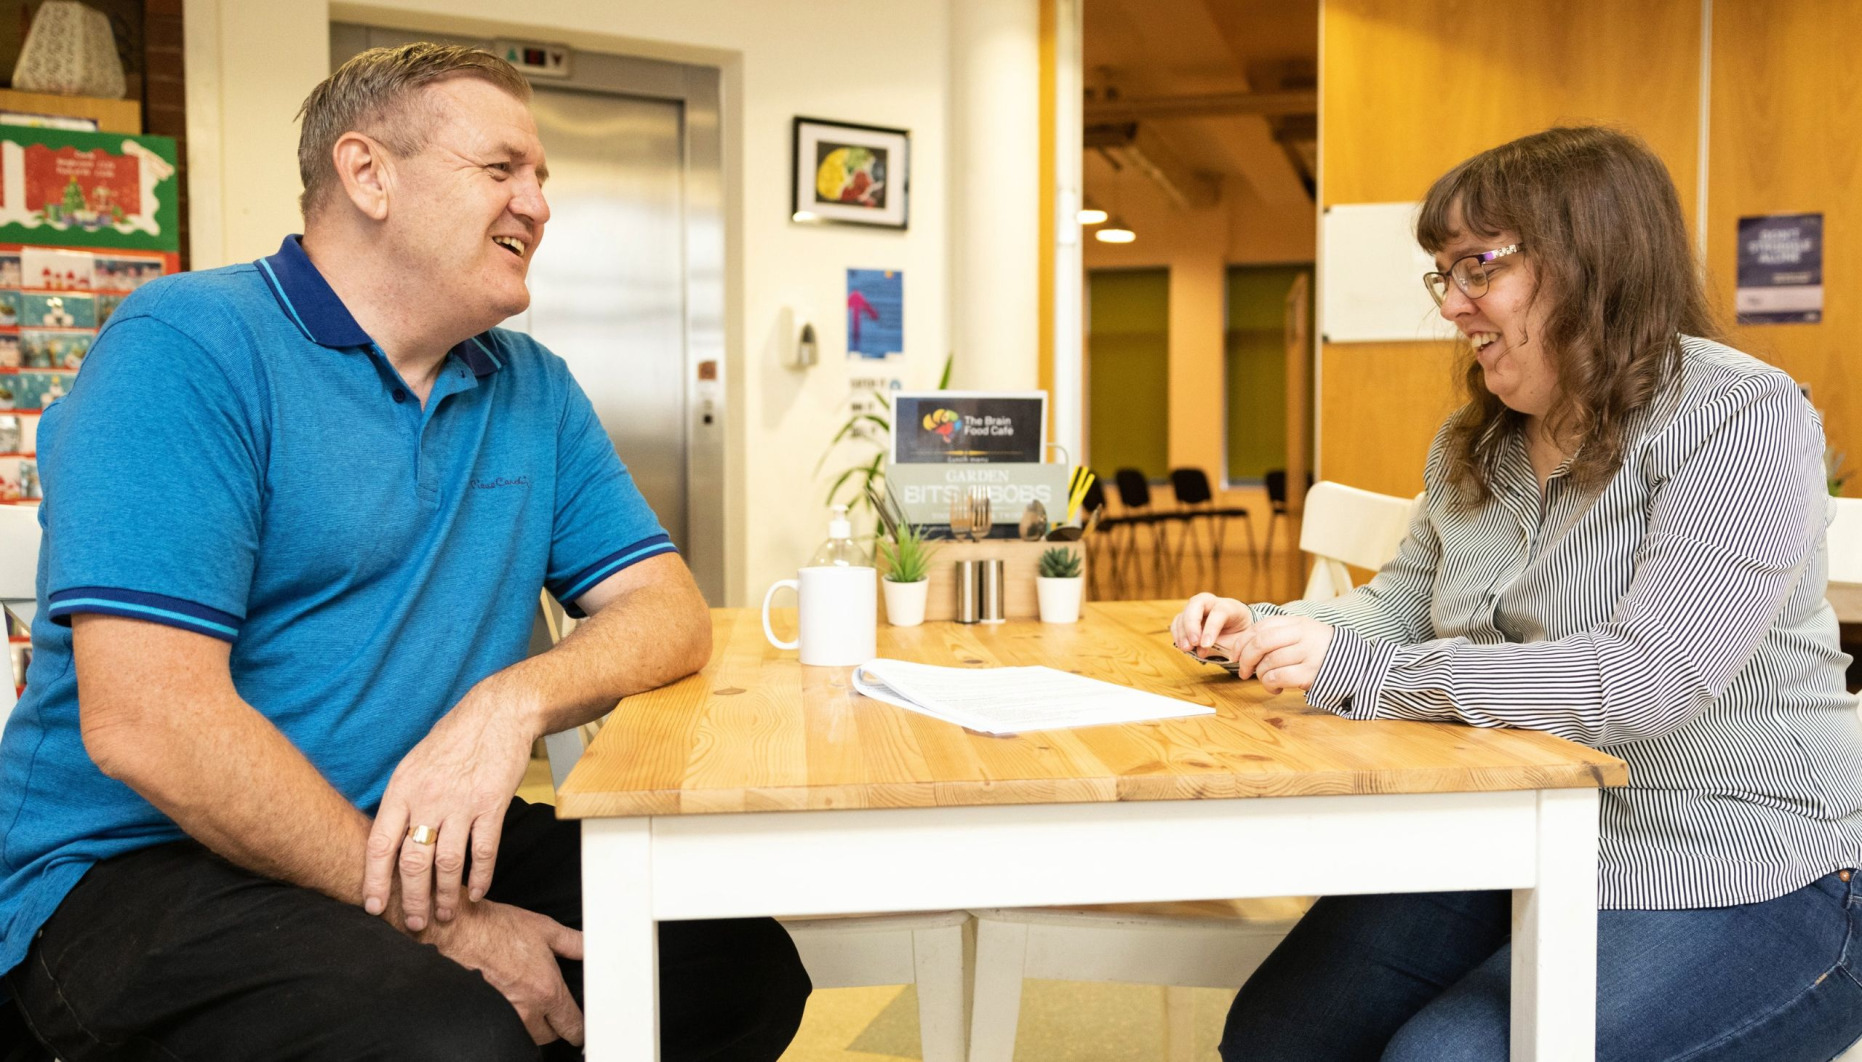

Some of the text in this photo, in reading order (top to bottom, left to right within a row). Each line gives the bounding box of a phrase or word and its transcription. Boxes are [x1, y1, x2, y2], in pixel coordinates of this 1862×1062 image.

[964, 415, 1012, 426] The Brain
[964, 426, 990, 436] Food
[945, 469, 1010, 482] GARDEN
[904, 485, 960, 504] BITS
[989, 485, 1052, 504] BOBS
